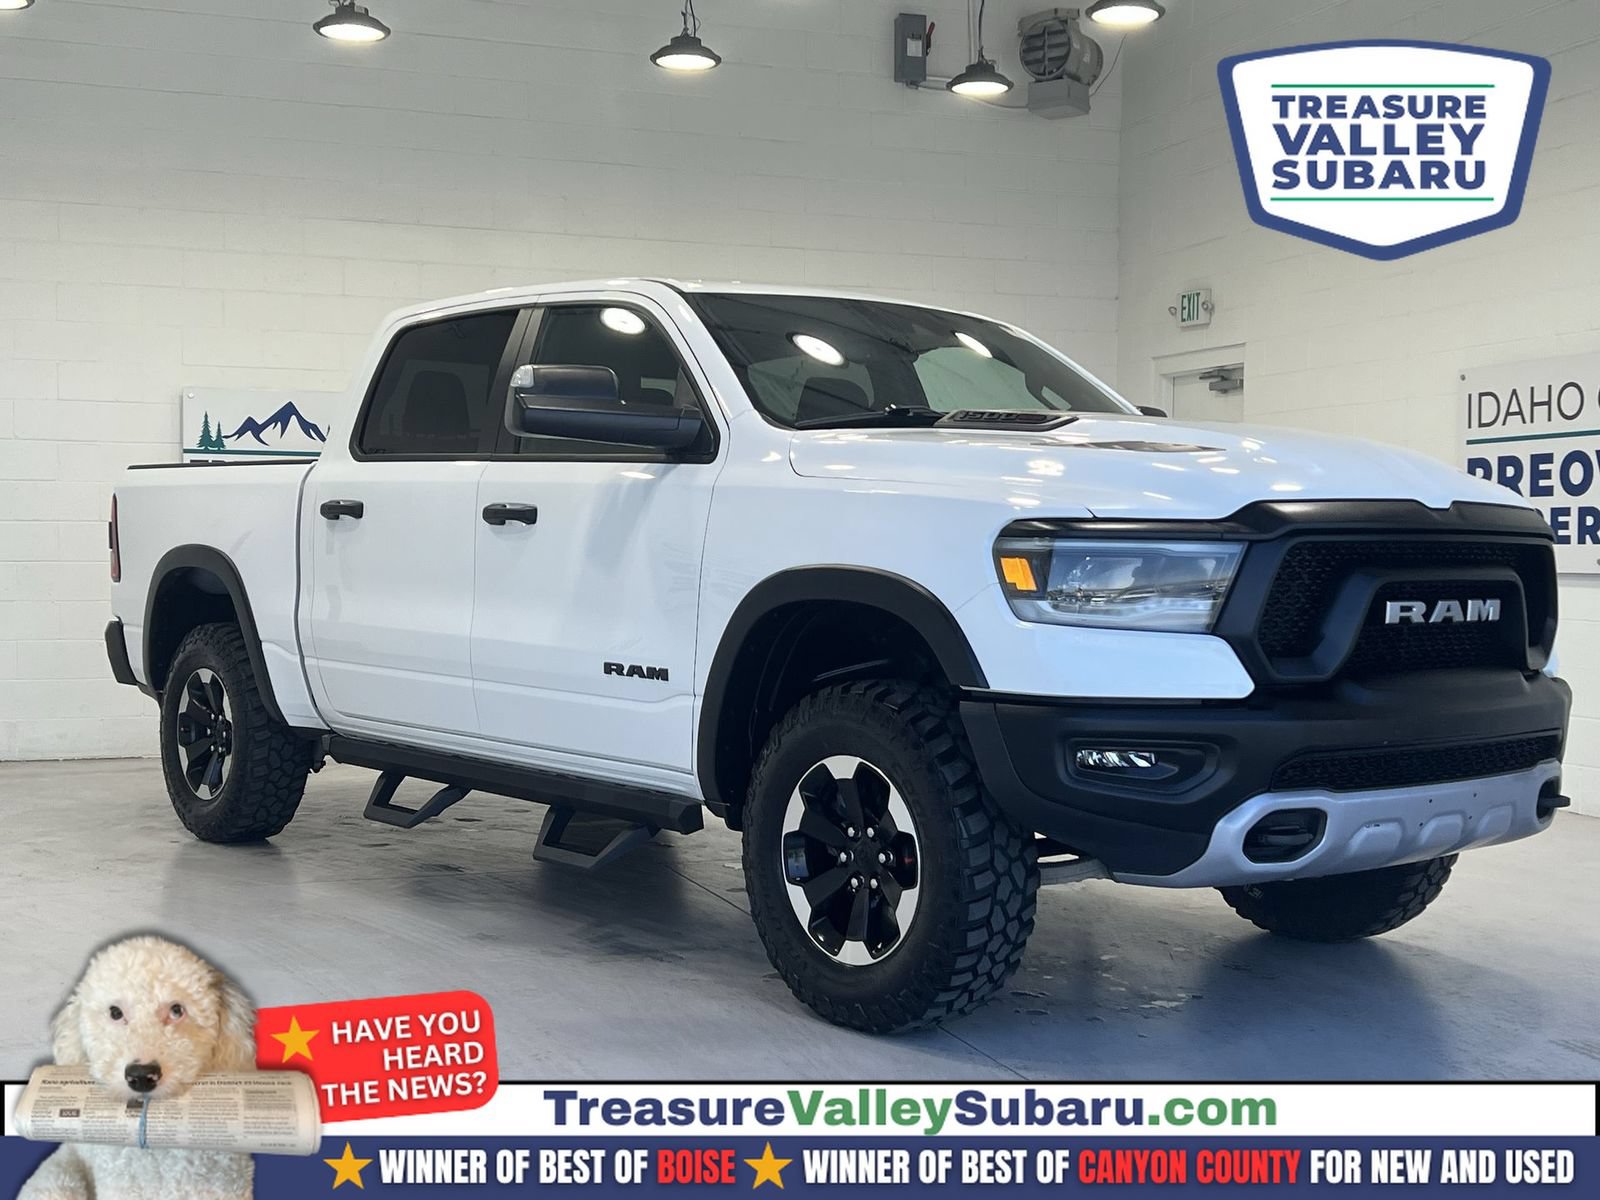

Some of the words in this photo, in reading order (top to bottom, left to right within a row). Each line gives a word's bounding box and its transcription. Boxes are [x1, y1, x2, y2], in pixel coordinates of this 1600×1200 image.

[1181, 292, 1200, 322] EXIT
[1467, 381, 1585, 429] IDAHO
[1384, 598, 1501, 625] RAM
[603, 661, 670, 682] RAM
